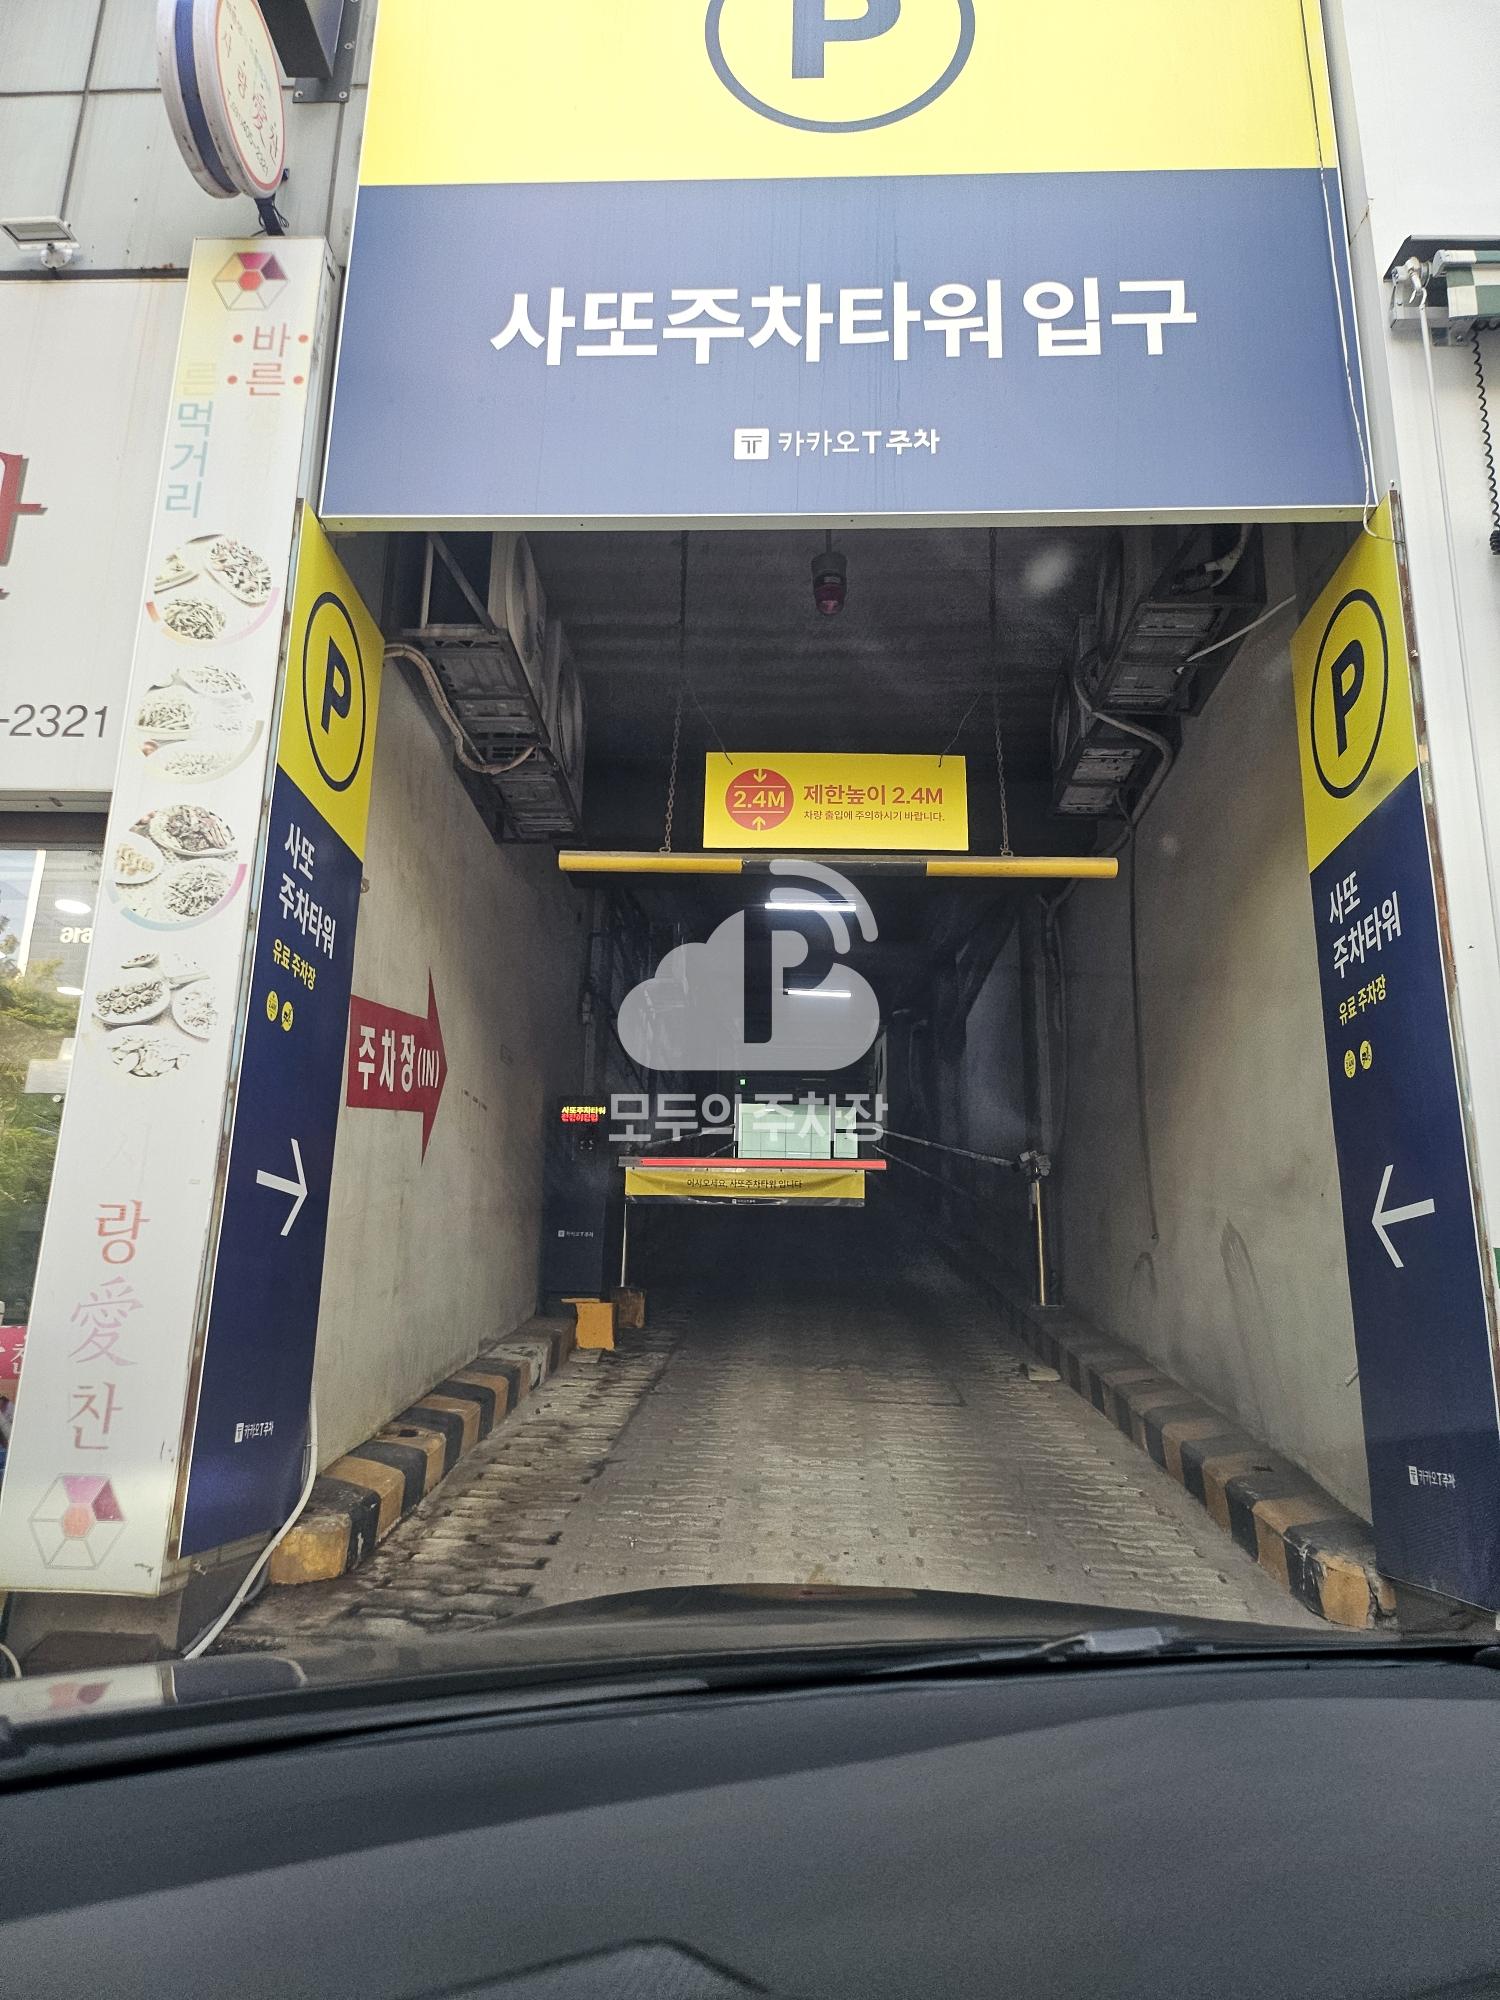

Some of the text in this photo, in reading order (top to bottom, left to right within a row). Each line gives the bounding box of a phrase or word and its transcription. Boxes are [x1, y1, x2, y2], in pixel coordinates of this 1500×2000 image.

[489, 276, 1197, 366] 사또주차타워 입구
[885, 428, 941, 456] 주차
[320, 634, 351, 735] P
[1330, 638, 1365, 758] P
[732, 790, 785, 808] 2.4M
[803, 784, 944, 805] 제한높이 2.4M
[803, 810, 946, 823] 차량 출입에 주의하시기 바랍니다.
[284, 821, 316, 882] 사또
[278, 872, 337, 960] 주차타워
[1328, 870, 1361, 925] 사또
[1332, 889, 1402, 979] 주차타워
[272, 937, 317, 991] 유료 주차장
[1338, 973, 1387, 1026] 유료 주차장
